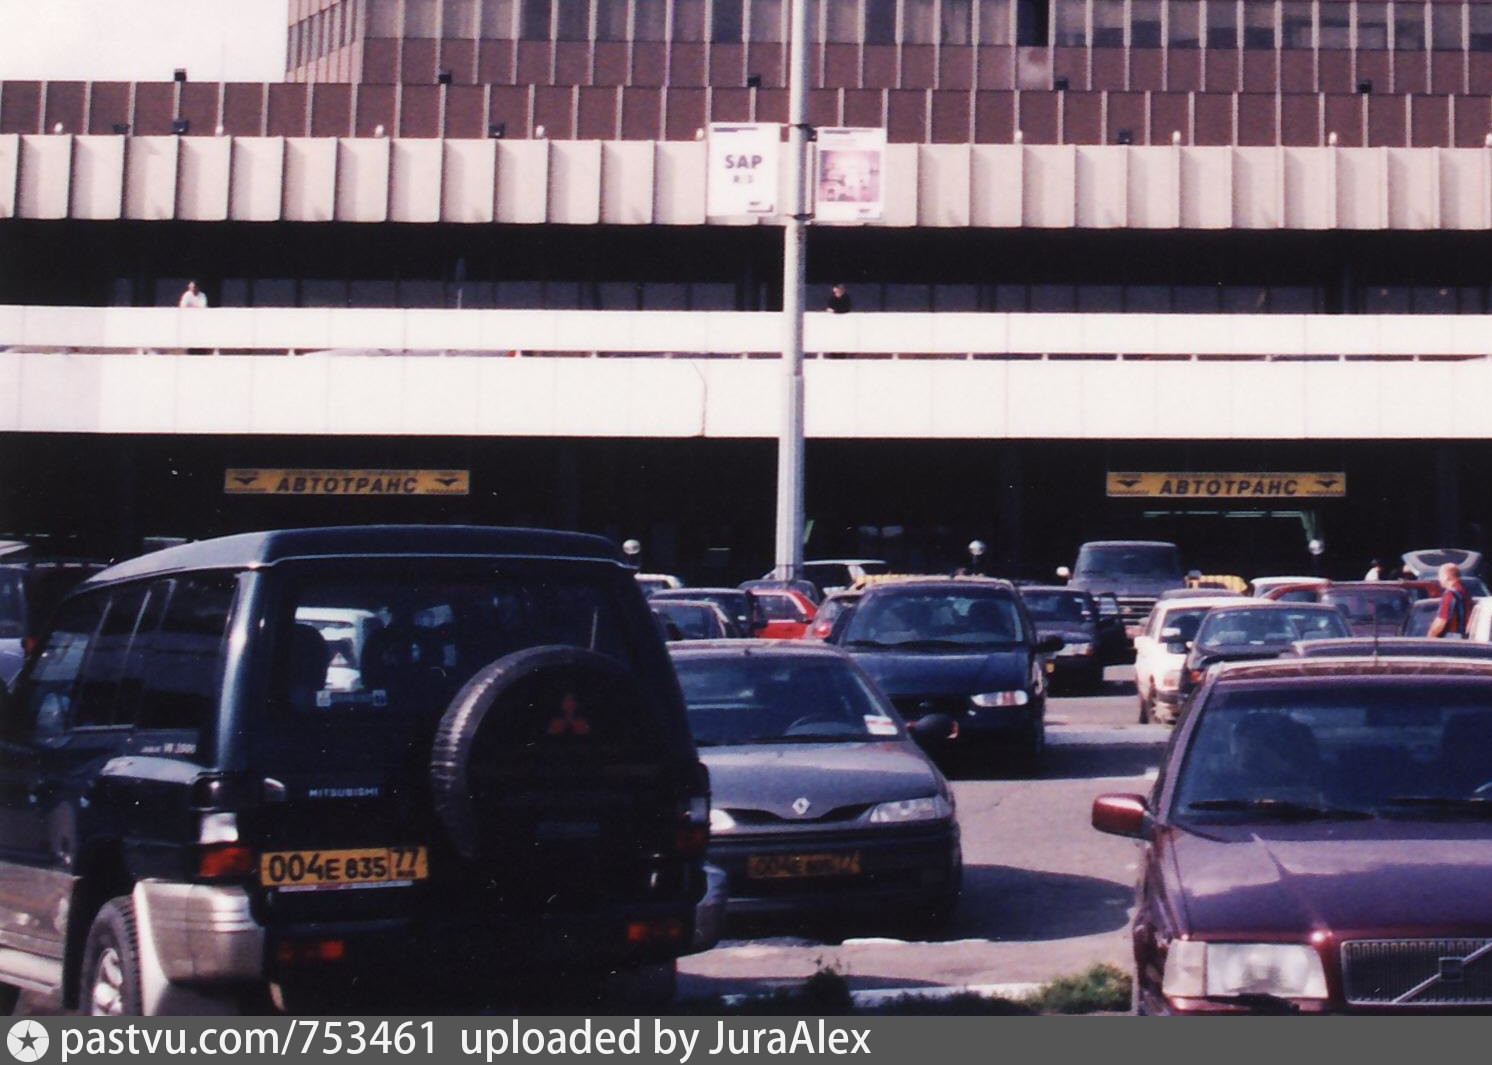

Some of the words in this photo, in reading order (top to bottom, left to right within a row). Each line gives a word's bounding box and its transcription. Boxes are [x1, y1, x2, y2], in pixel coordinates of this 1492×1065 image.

[724, 154, 762, 169] SAP
[276, 477, 419, 494] АВТОТРАНС
[1159, 479, 1299, 496] АВТОТРАНС
[308, 786, 379, 798] MITSUBISHI
